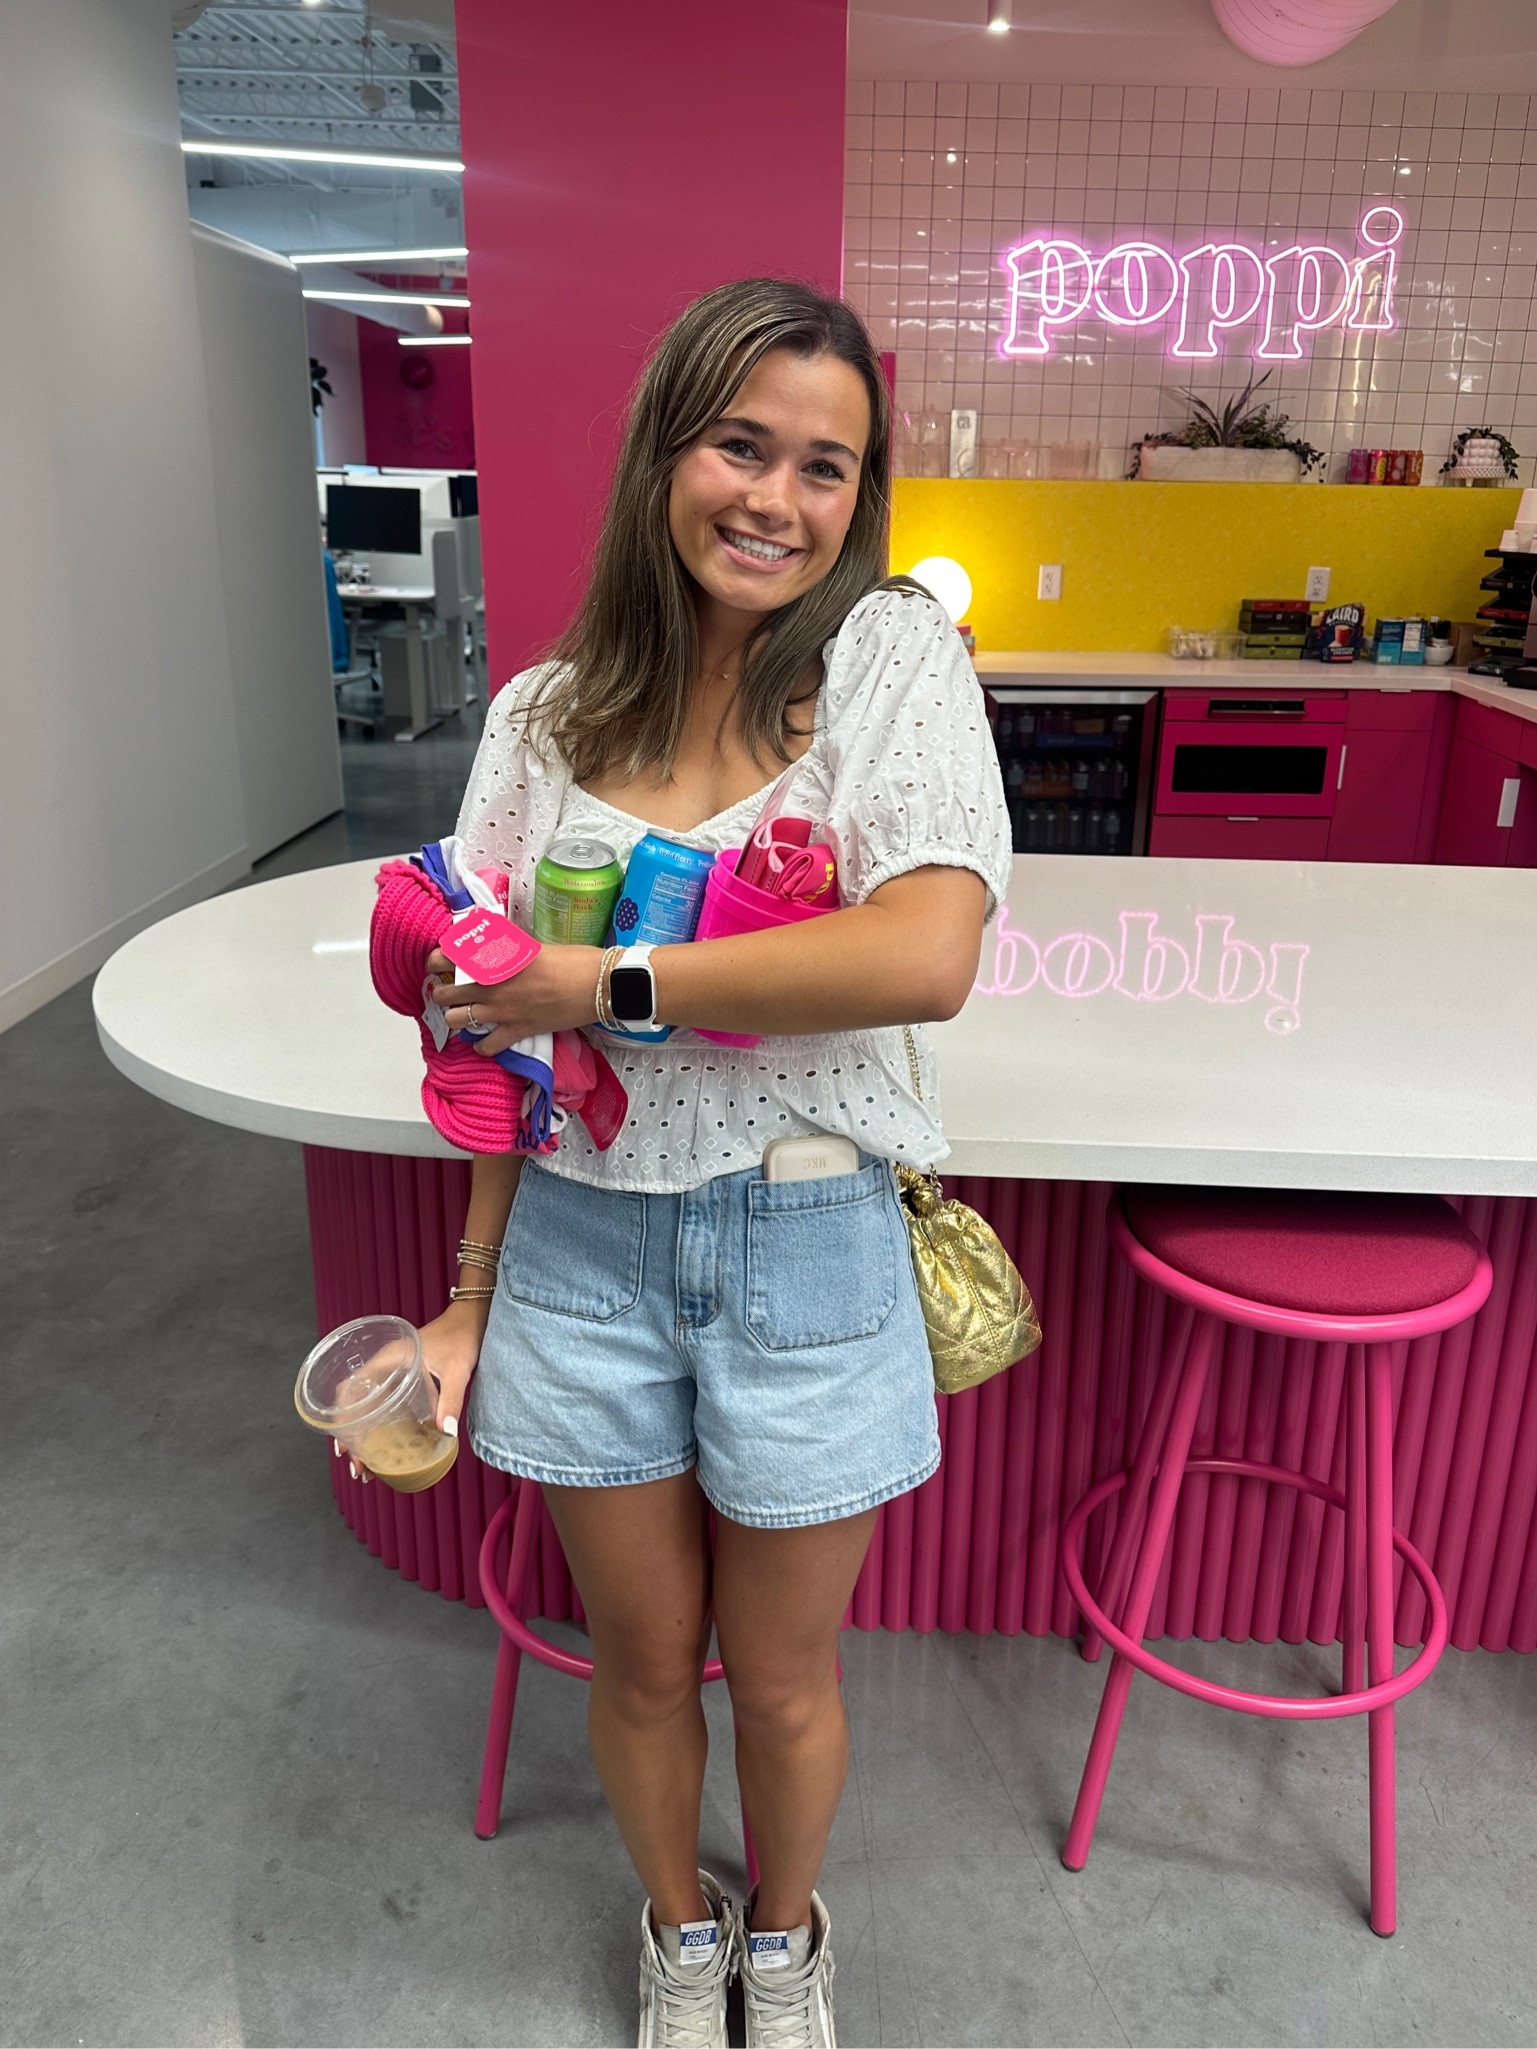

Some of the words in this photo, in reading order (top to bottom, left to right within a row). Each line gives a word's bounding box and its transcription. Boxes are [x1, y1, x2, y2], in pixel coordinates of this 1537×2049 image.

[1003, 206, 1403, 359] poppi
[1325, 606, 1360, 625] LAIRD
[563, 877, 606, 887] Watermelon
[685, 900, 695, 909] 30
[453, 918, 491, 948] poppi
[685, 1929, 712, 1946] GGDB
[756, 1937, 782, 1952] GGDB
